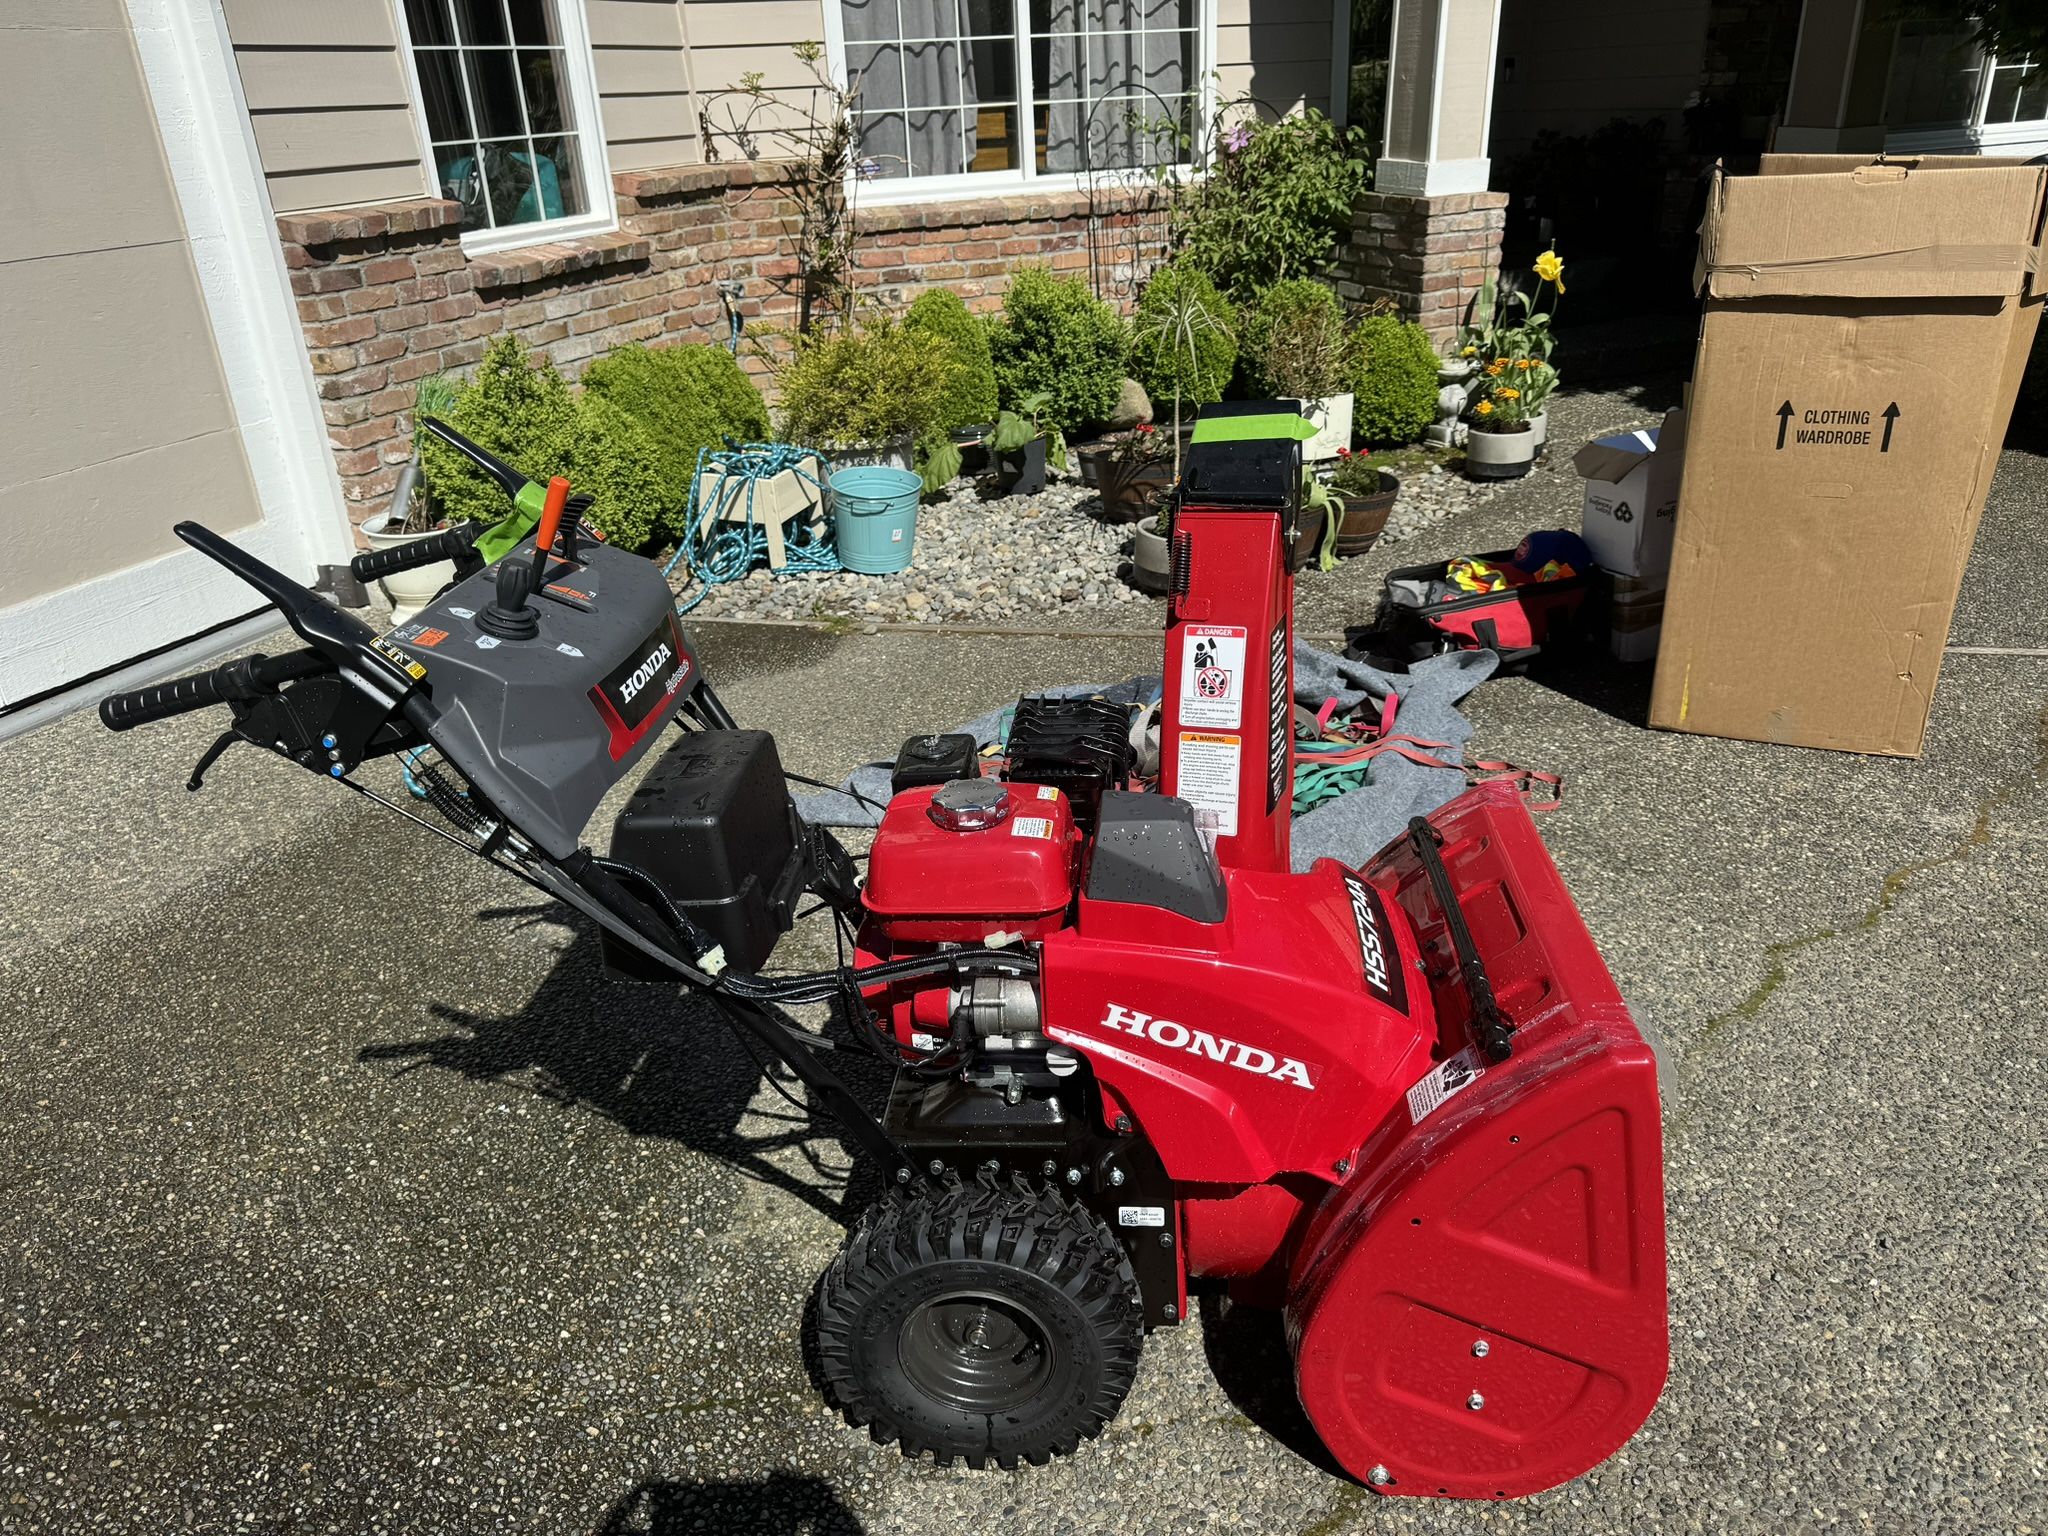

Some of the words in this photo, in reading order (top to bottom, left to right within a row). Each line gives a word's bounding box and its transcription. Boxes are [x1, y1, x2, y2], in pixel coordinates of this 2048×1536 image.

[1804, 410, 1870, 425] CLOTHING
[1796, 430, 1871, 445] WARDROBE
[1204, 628, 1232, 636] DANGER
[619, 642, 672, 704] HONDA
[1199, 735, 1226, 743] WARNING
[1345, 877, 1389, 992] HSS724A
[1101, 1002, 1315, 1090] HONDA
